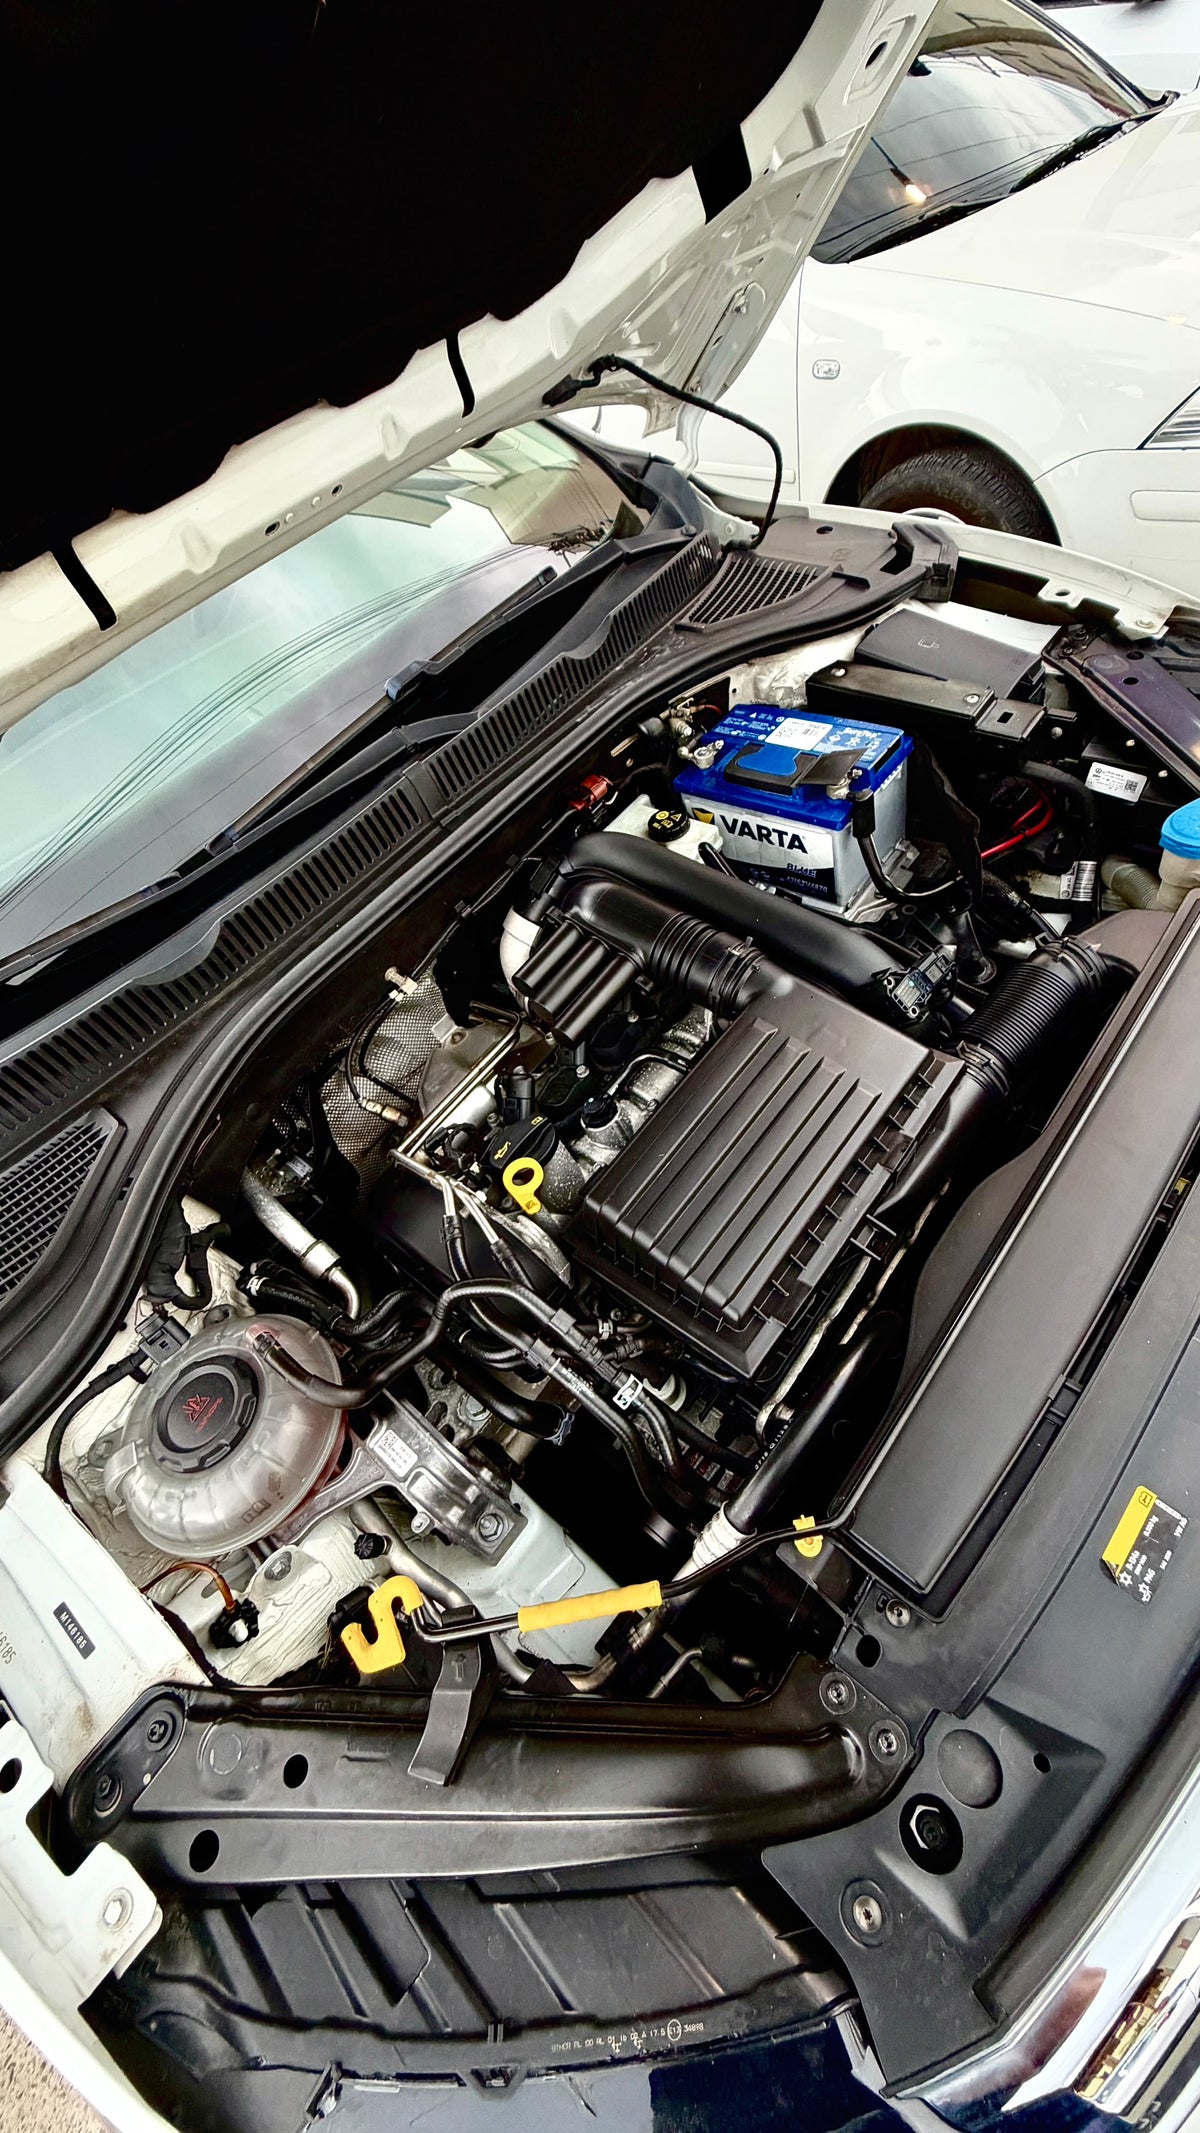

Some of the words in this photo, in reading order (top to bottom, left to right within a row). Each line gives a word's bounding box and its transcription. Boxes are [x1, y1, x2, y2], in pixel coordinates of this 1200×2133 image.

[720, 814, 808, 854] VARTA
[787, 863, 817, 879] BLUE
[1143, 1568, 1156, 1584] PAG
[60, 1611, 88, 1649] M146185
